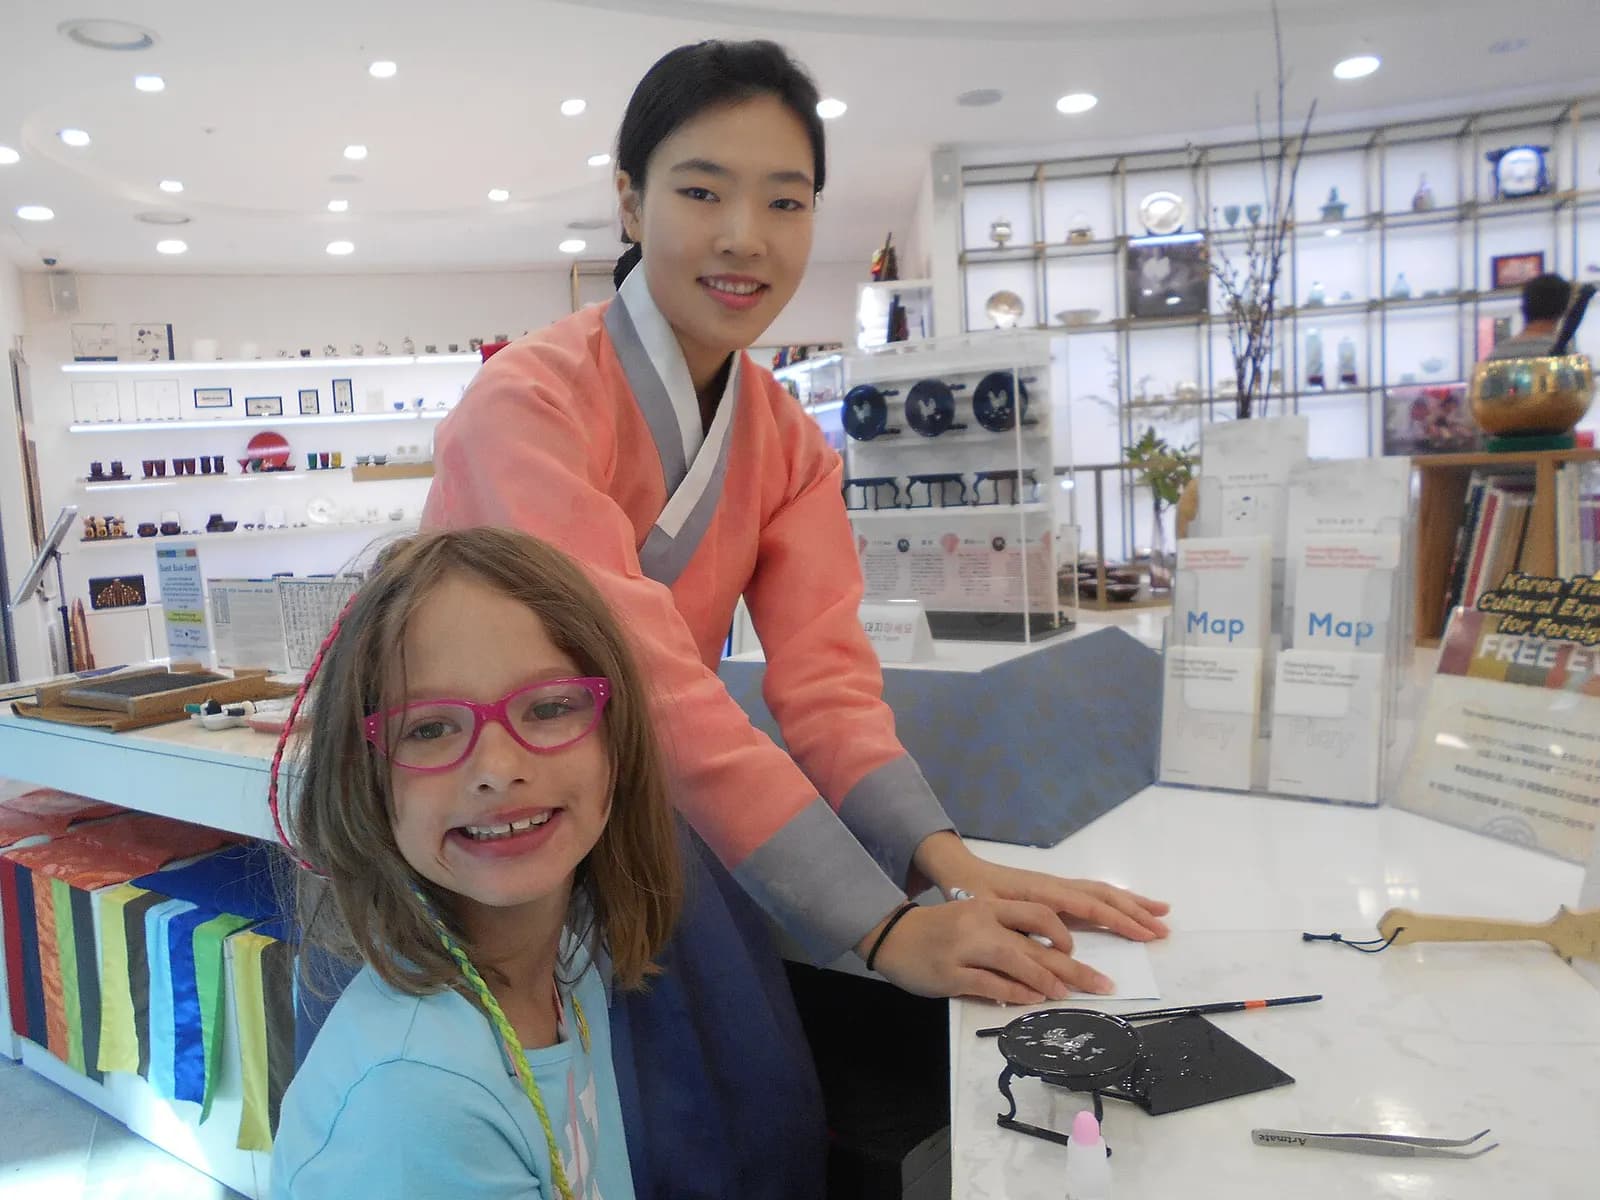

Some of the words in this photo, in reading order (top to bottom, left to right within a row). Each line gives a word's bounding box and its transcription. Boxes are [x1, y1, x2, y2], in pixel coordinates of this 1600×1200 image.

[1501, 573, 1562, 594] Korea
[1479, 592, 1559, 615] Cultural
[1187, 611, 1245, 642] Map
[1308, 612, 1374, 646] Map
[1499, 614, 1532, 633] for
[1478, 634, 1558, 668] FREE
[1258, 1134, 1307, 1146] Artmate
